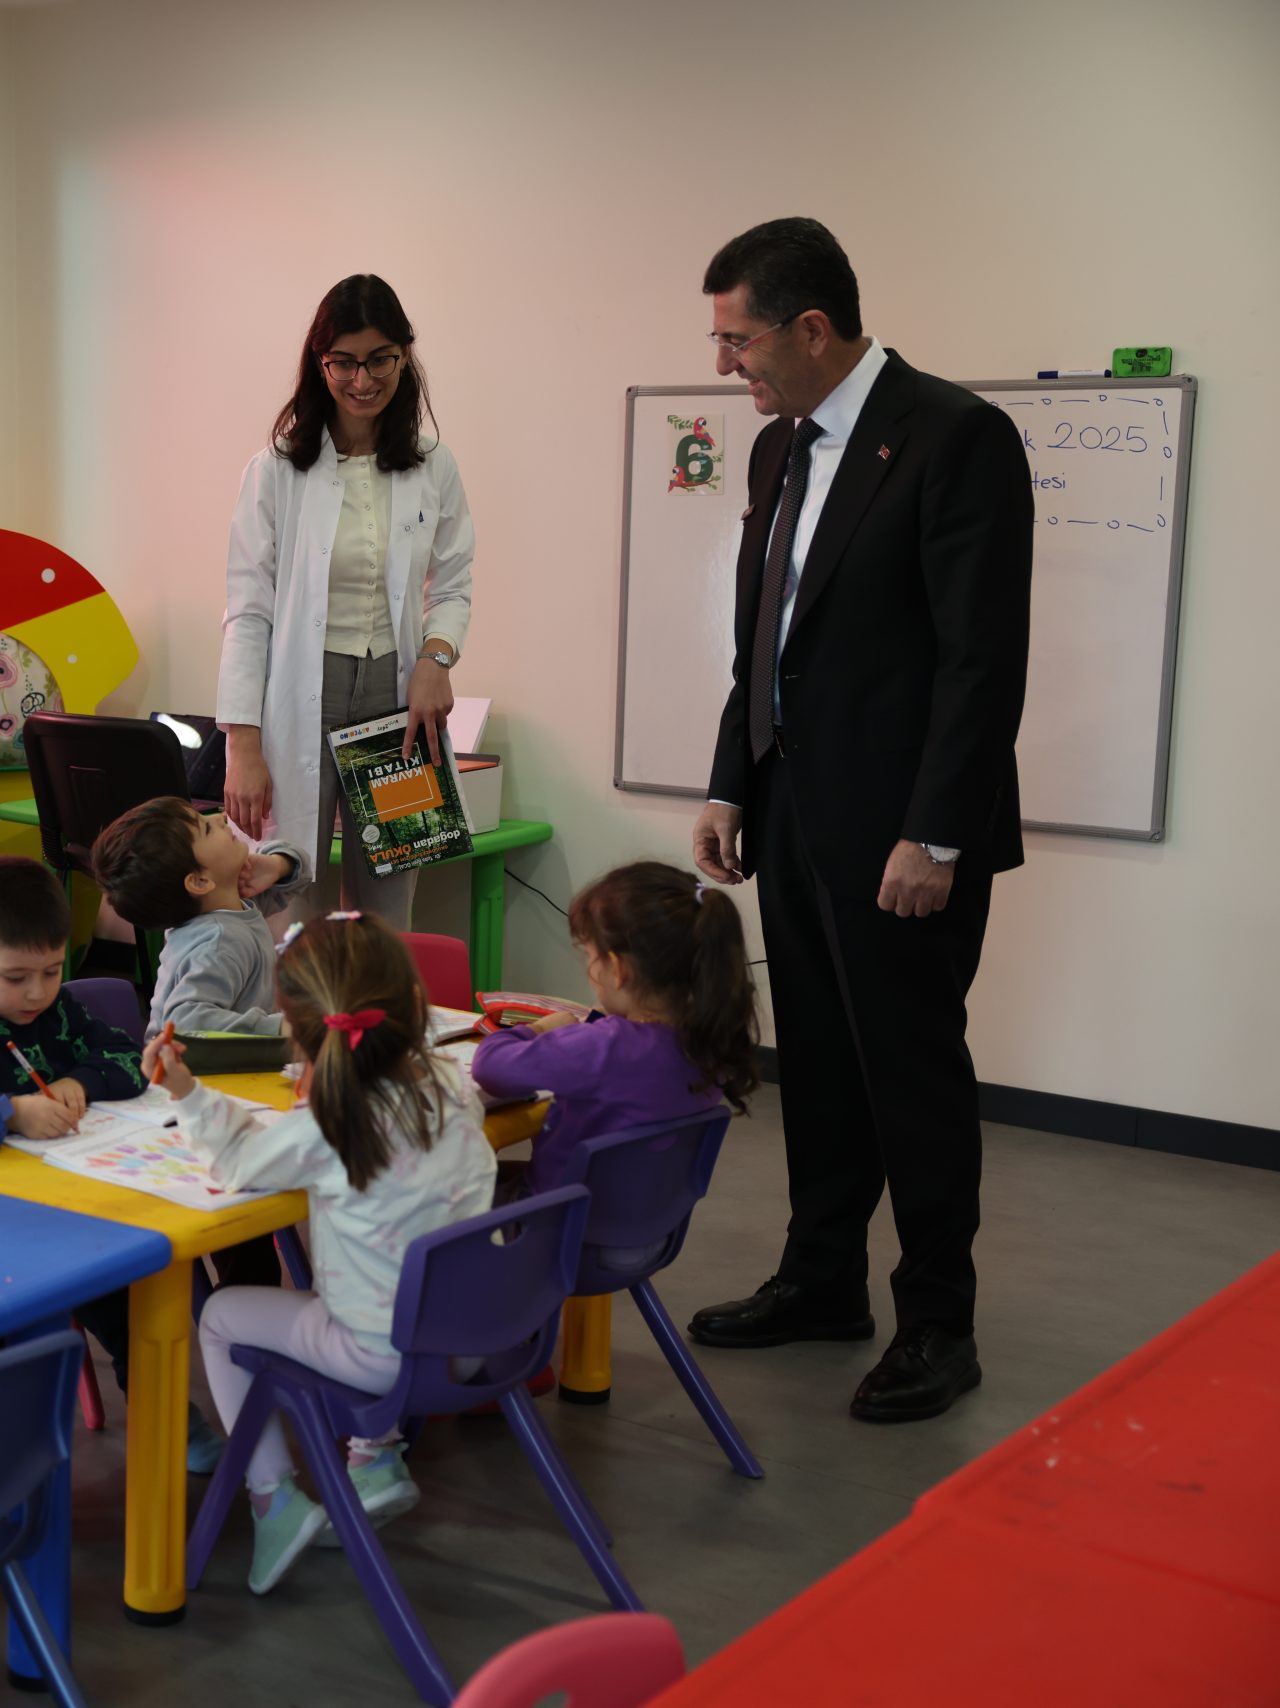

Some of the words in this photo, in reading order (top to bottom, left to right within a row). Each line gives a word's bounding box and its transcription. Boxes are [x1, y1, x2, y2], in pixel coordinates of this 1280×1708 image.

[1047, 422, 1148, 453] 2025
[675, 434, 714, 483] 6
[367, 755, 420, 778] KİTABI
[371, 766, 423, 789] KAVRAM
[413, 829, 461, 849] doğadan
[370, 843, 412, 863] OKULA
